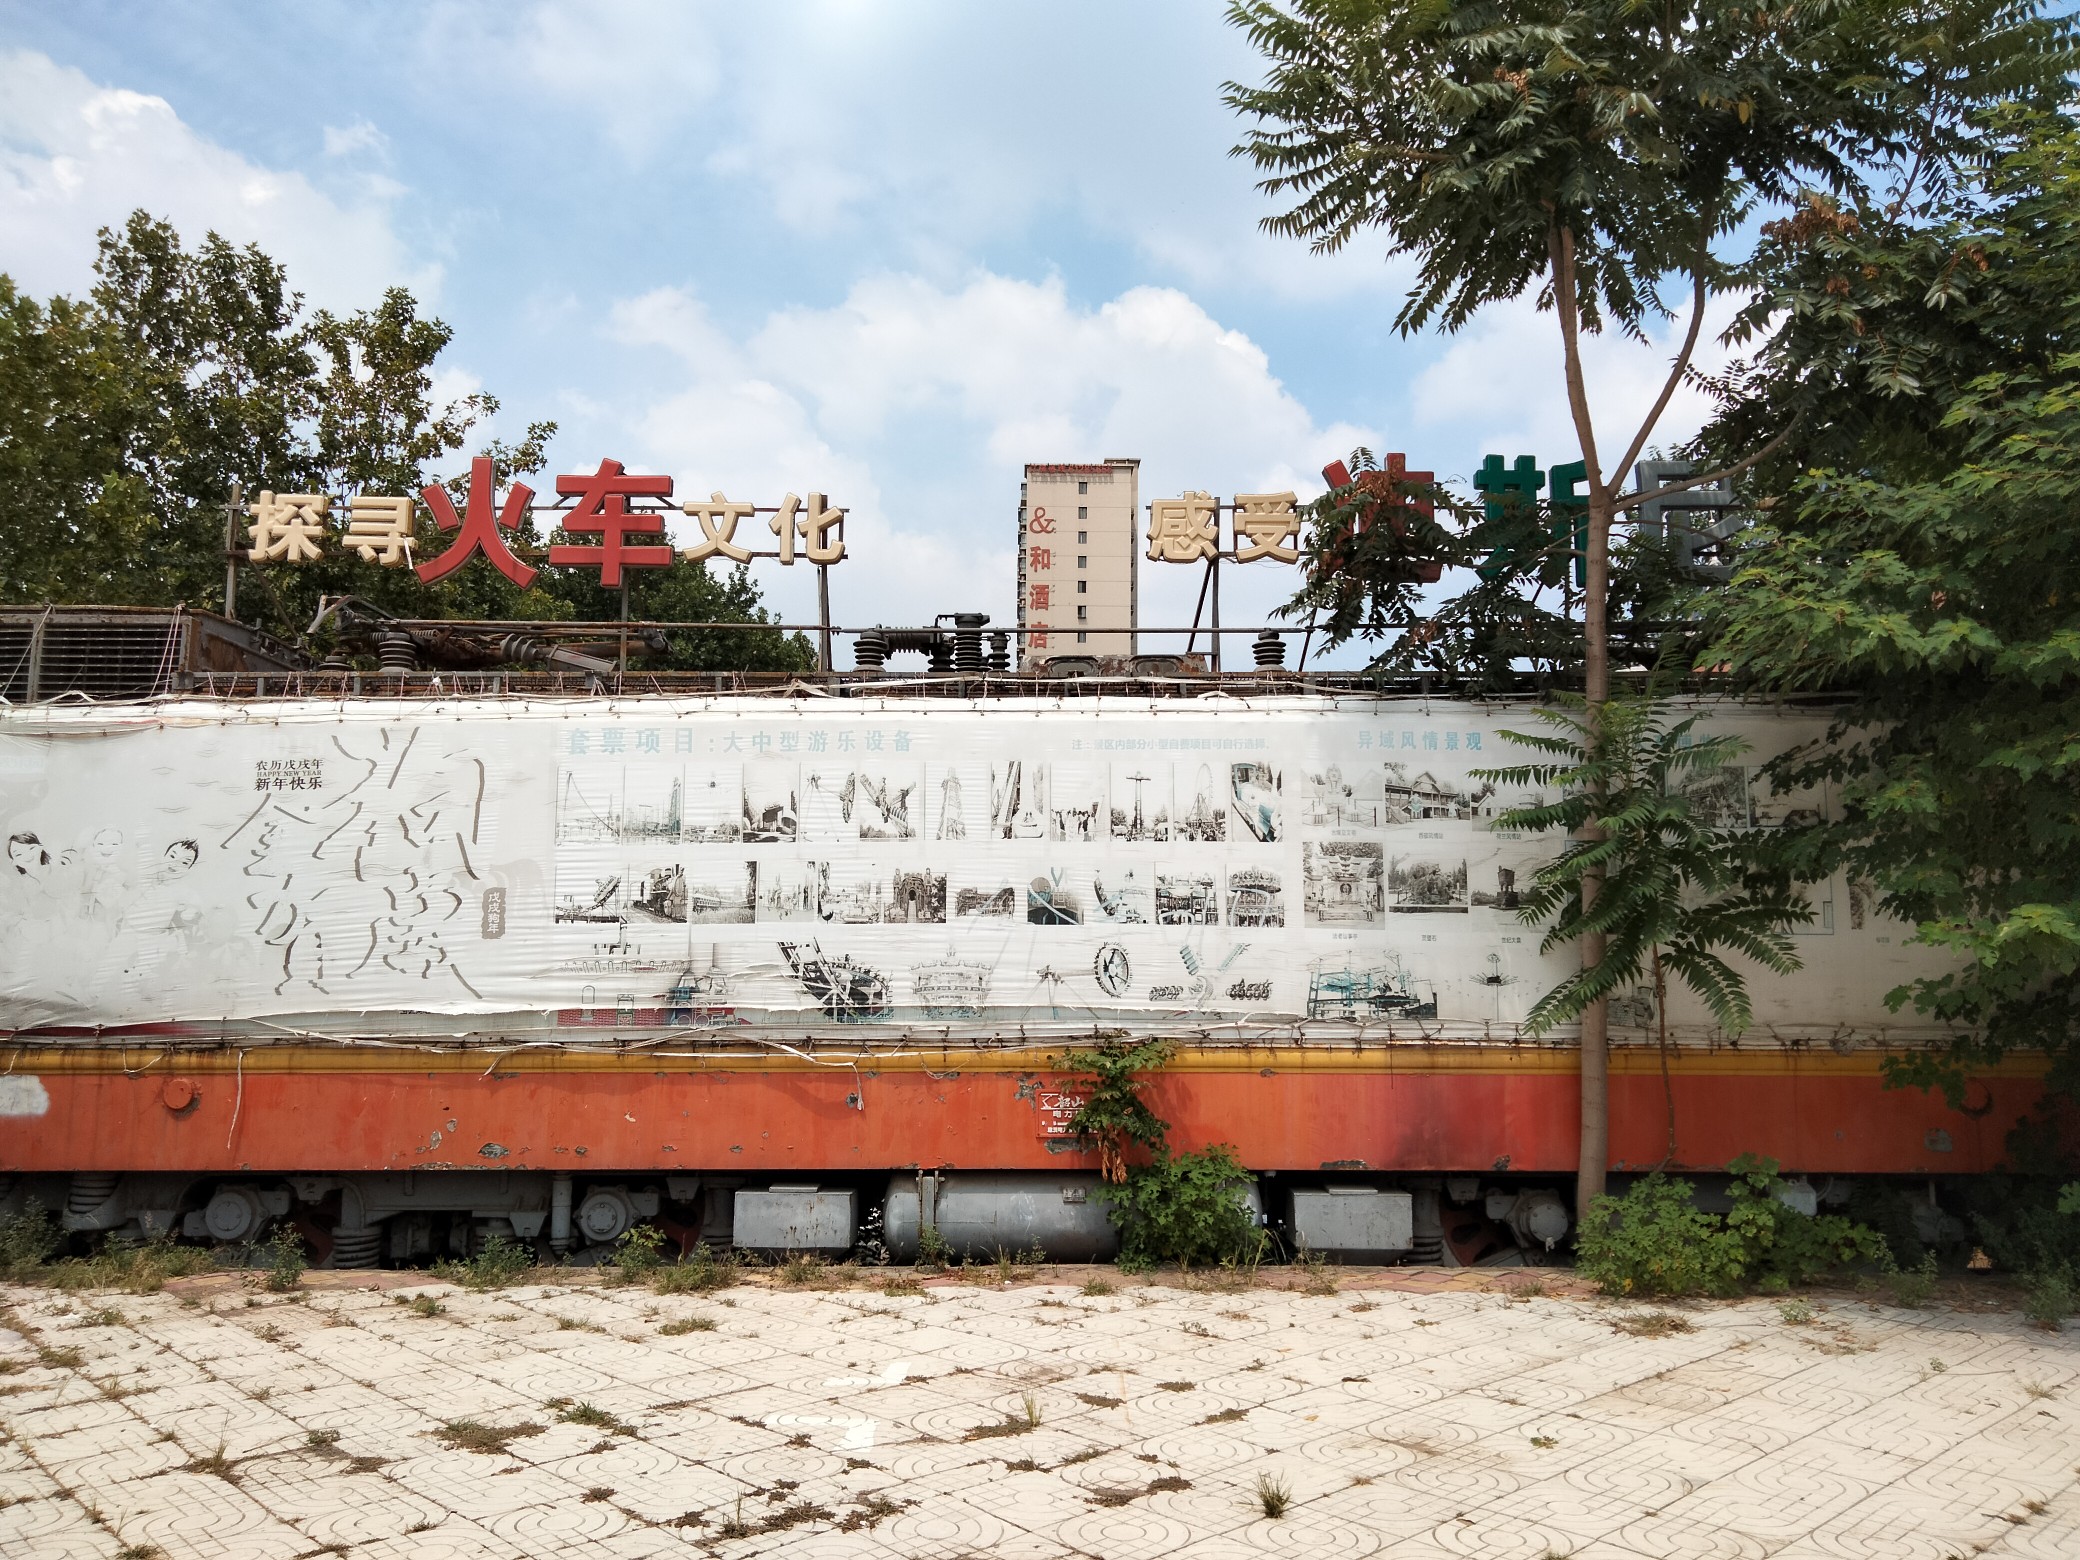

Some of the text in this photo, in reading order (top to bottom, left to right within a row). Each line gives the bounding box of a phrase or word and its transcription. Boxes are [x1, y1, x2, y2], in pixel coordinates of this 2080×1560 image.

[247, 455, 845, 591] 探寻火车文化
[1357, 730, 1483, 751] 异域风情景观
[255, 758, 324, 771] 农历戊戌年
[253, 776, 323, 791] 新年快乐
[487, 892, 501, 933] 戊戌狗年
